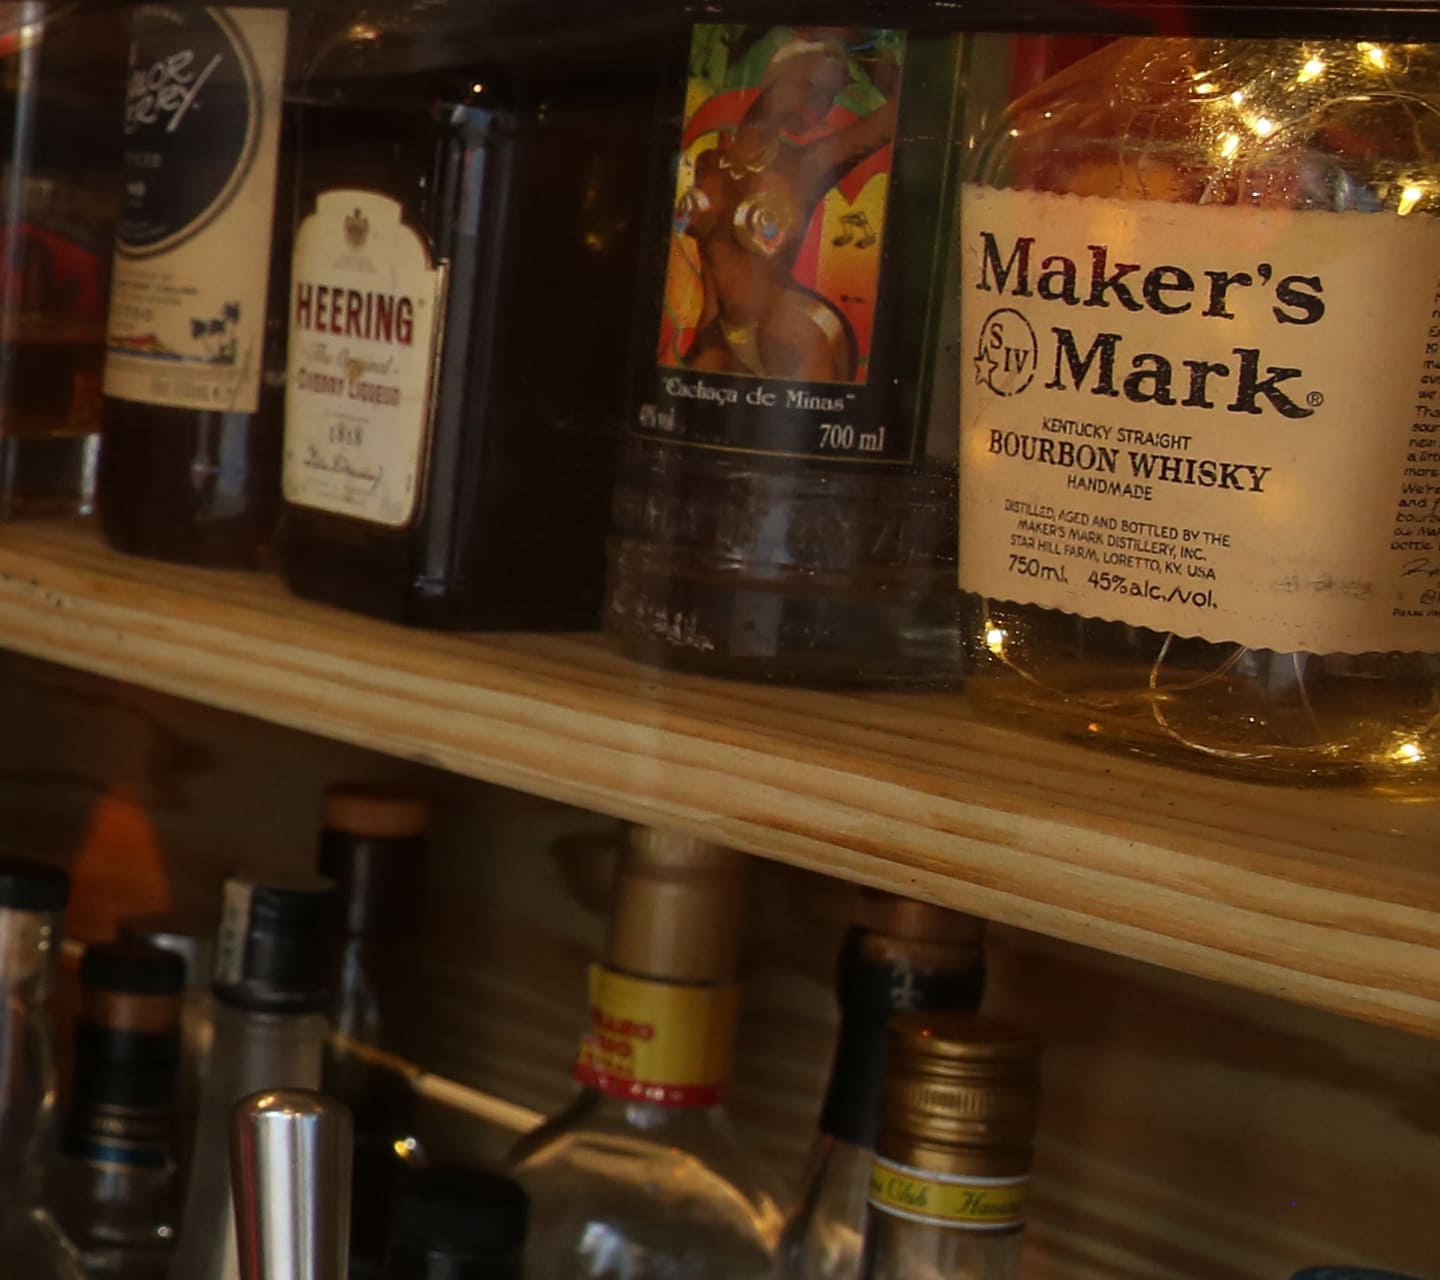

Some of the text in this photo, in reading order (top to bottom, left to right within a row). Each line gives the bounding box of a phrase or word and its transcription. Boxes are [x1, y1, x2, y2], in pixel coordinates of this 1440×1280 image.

[975, 230, 1326, 326] Maker's
[297, 282, 414, 346] HEERING
[1044, 327, 1314, 419] Mark
[746, 385, 777, 407] de
[820, 423, 885, 452] 700 ml
[1041, 417, 1192, 451] KENTUCKY STRAIGHT
[989, 429, 1272, 493] BOURBON WHISKY
[1067, 475, 1153, 501] HANDMADE
[1058, 509, 1088, 526] AGED
[1092, 513, 1117, 531] AND
[1121, 518, 1179, 541] BOTTLED
[1182, 528, 1201, 542] BY
[1203, 531, 1231, 548] THE
[1068, 528, 1104, 546] MARK
[1181, 547, 1207, 562] INC.
[1010, 534, 1036, 549] STAR
[1037, 540, 1062, 556] HILL
[1064, 546, 1100, 564] FARM,
[1187, 566, 1217, 582] USA
